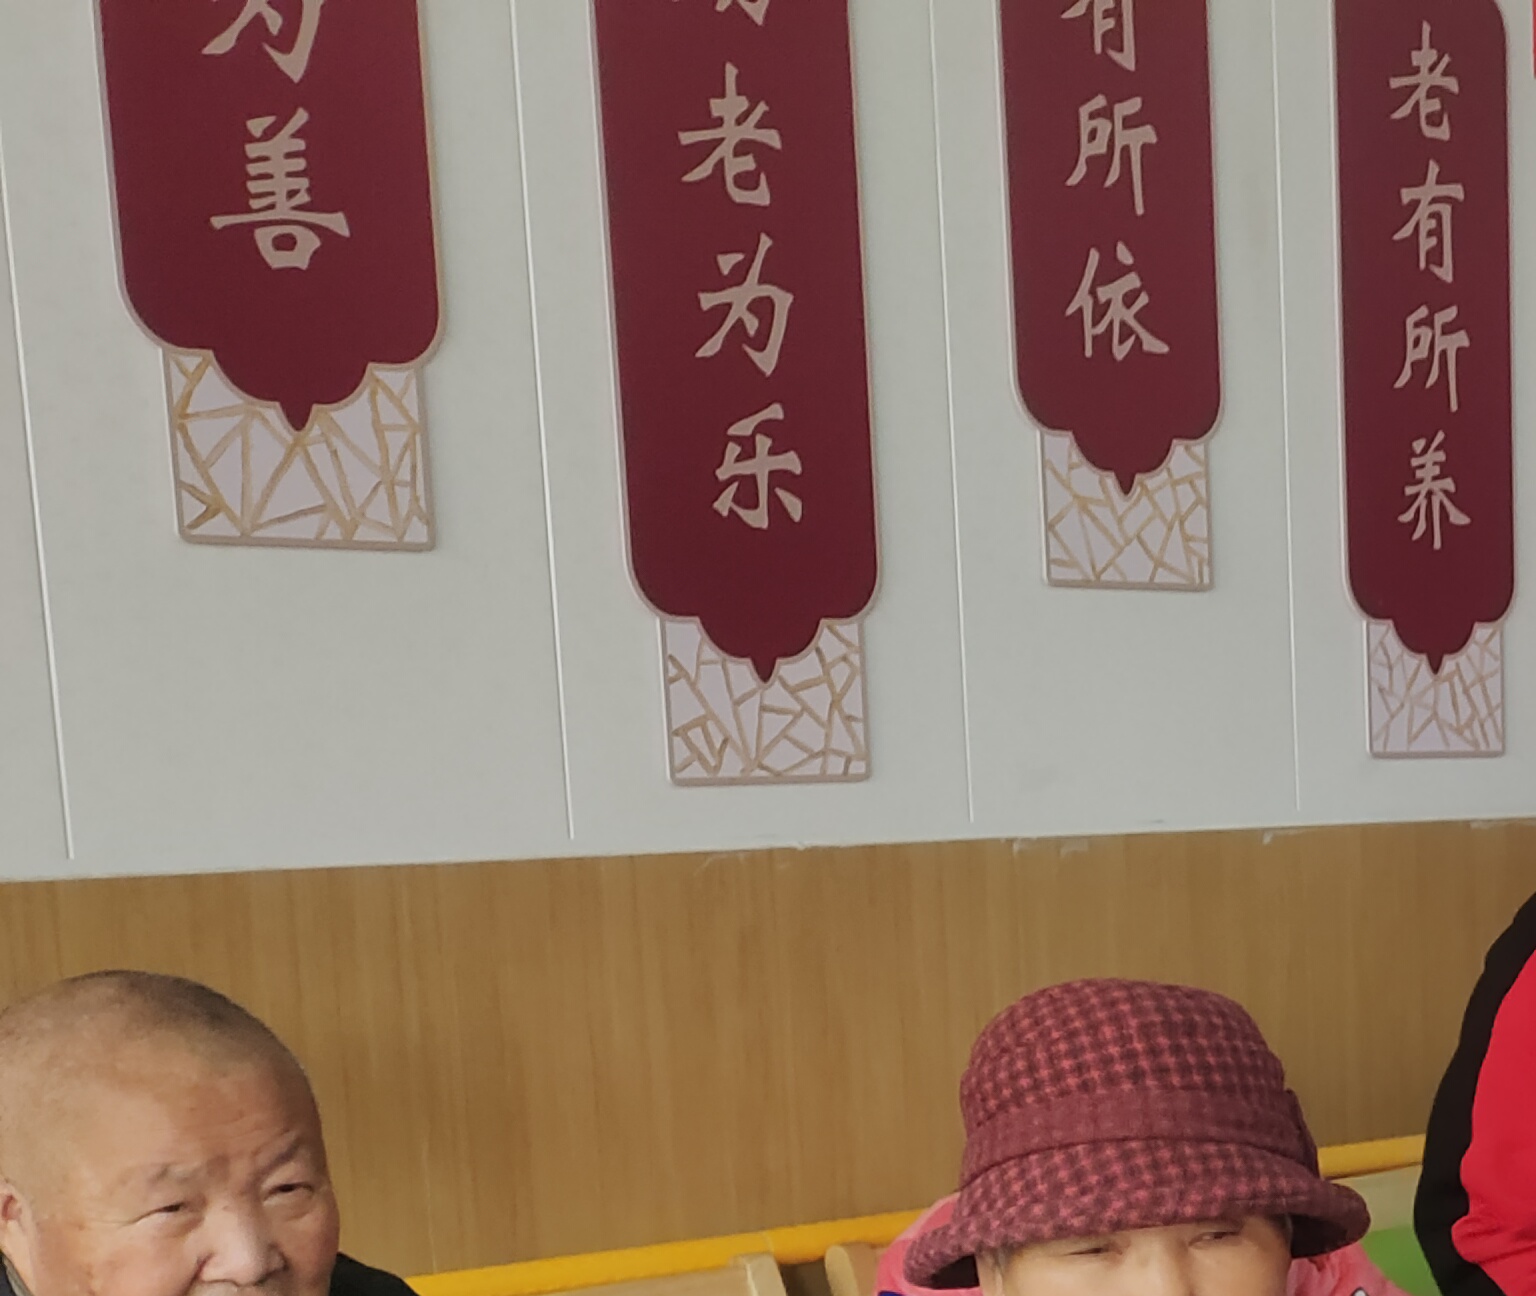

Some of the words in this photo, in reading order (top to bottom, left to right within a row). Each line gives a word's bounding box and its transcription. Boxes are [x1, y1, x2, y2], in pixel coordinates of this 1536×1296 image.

[672, 0, 803, 530] 老为乐
[1389, 20, 1471, 550] 老有所养
